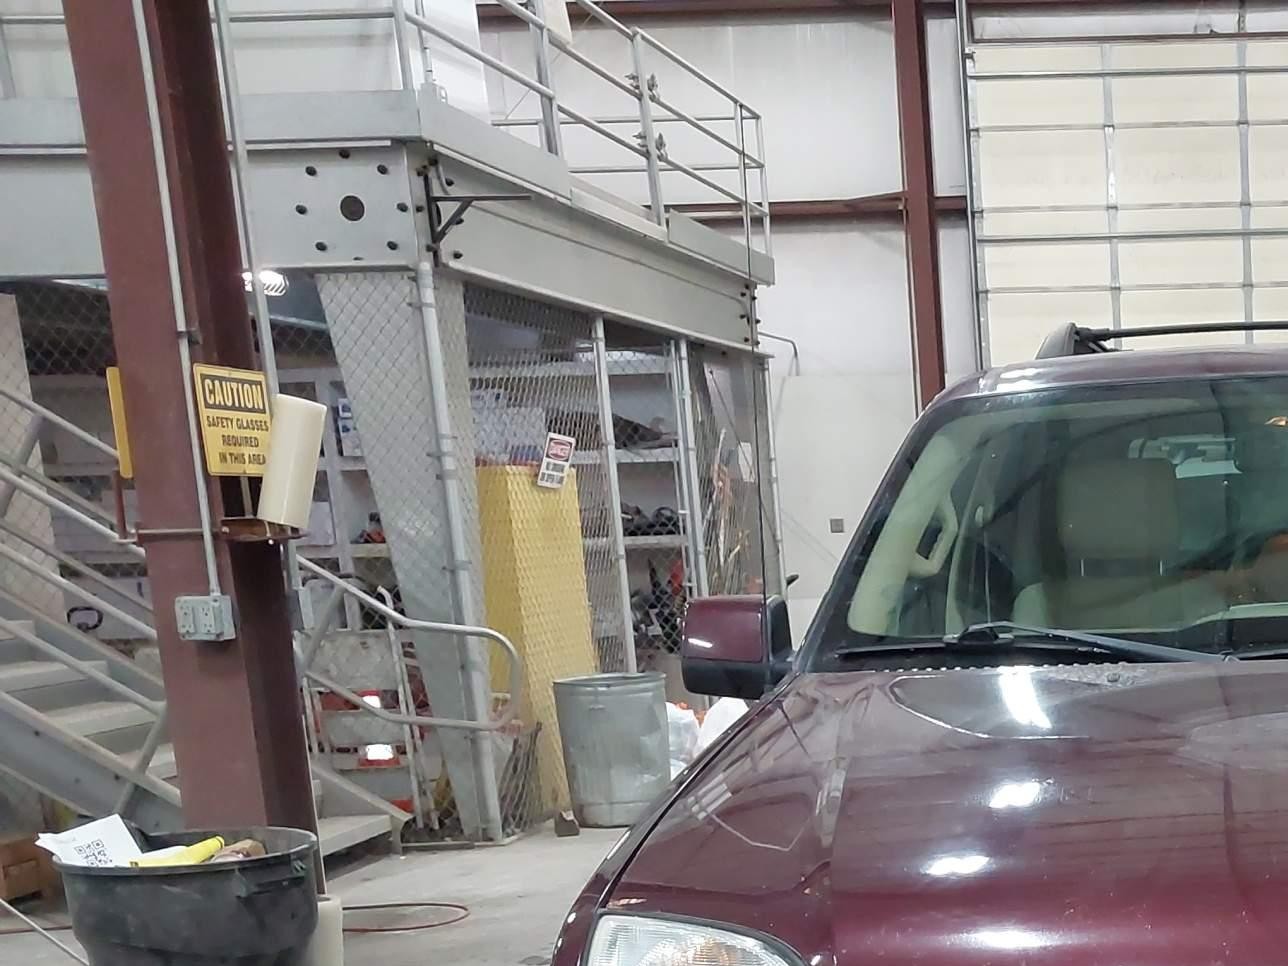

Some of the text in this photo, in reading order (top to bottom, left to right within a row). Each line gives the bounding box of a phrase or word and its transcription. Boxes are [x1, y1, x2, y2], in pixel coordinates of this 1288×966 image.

[204, 378, 264, 410] CAUTION
[206, 415, 269, 432] SAFETY GLASSES
[221, 434, 260, 448] REQUIRED
[219, 452, 266, 466] IN THIS AREA
